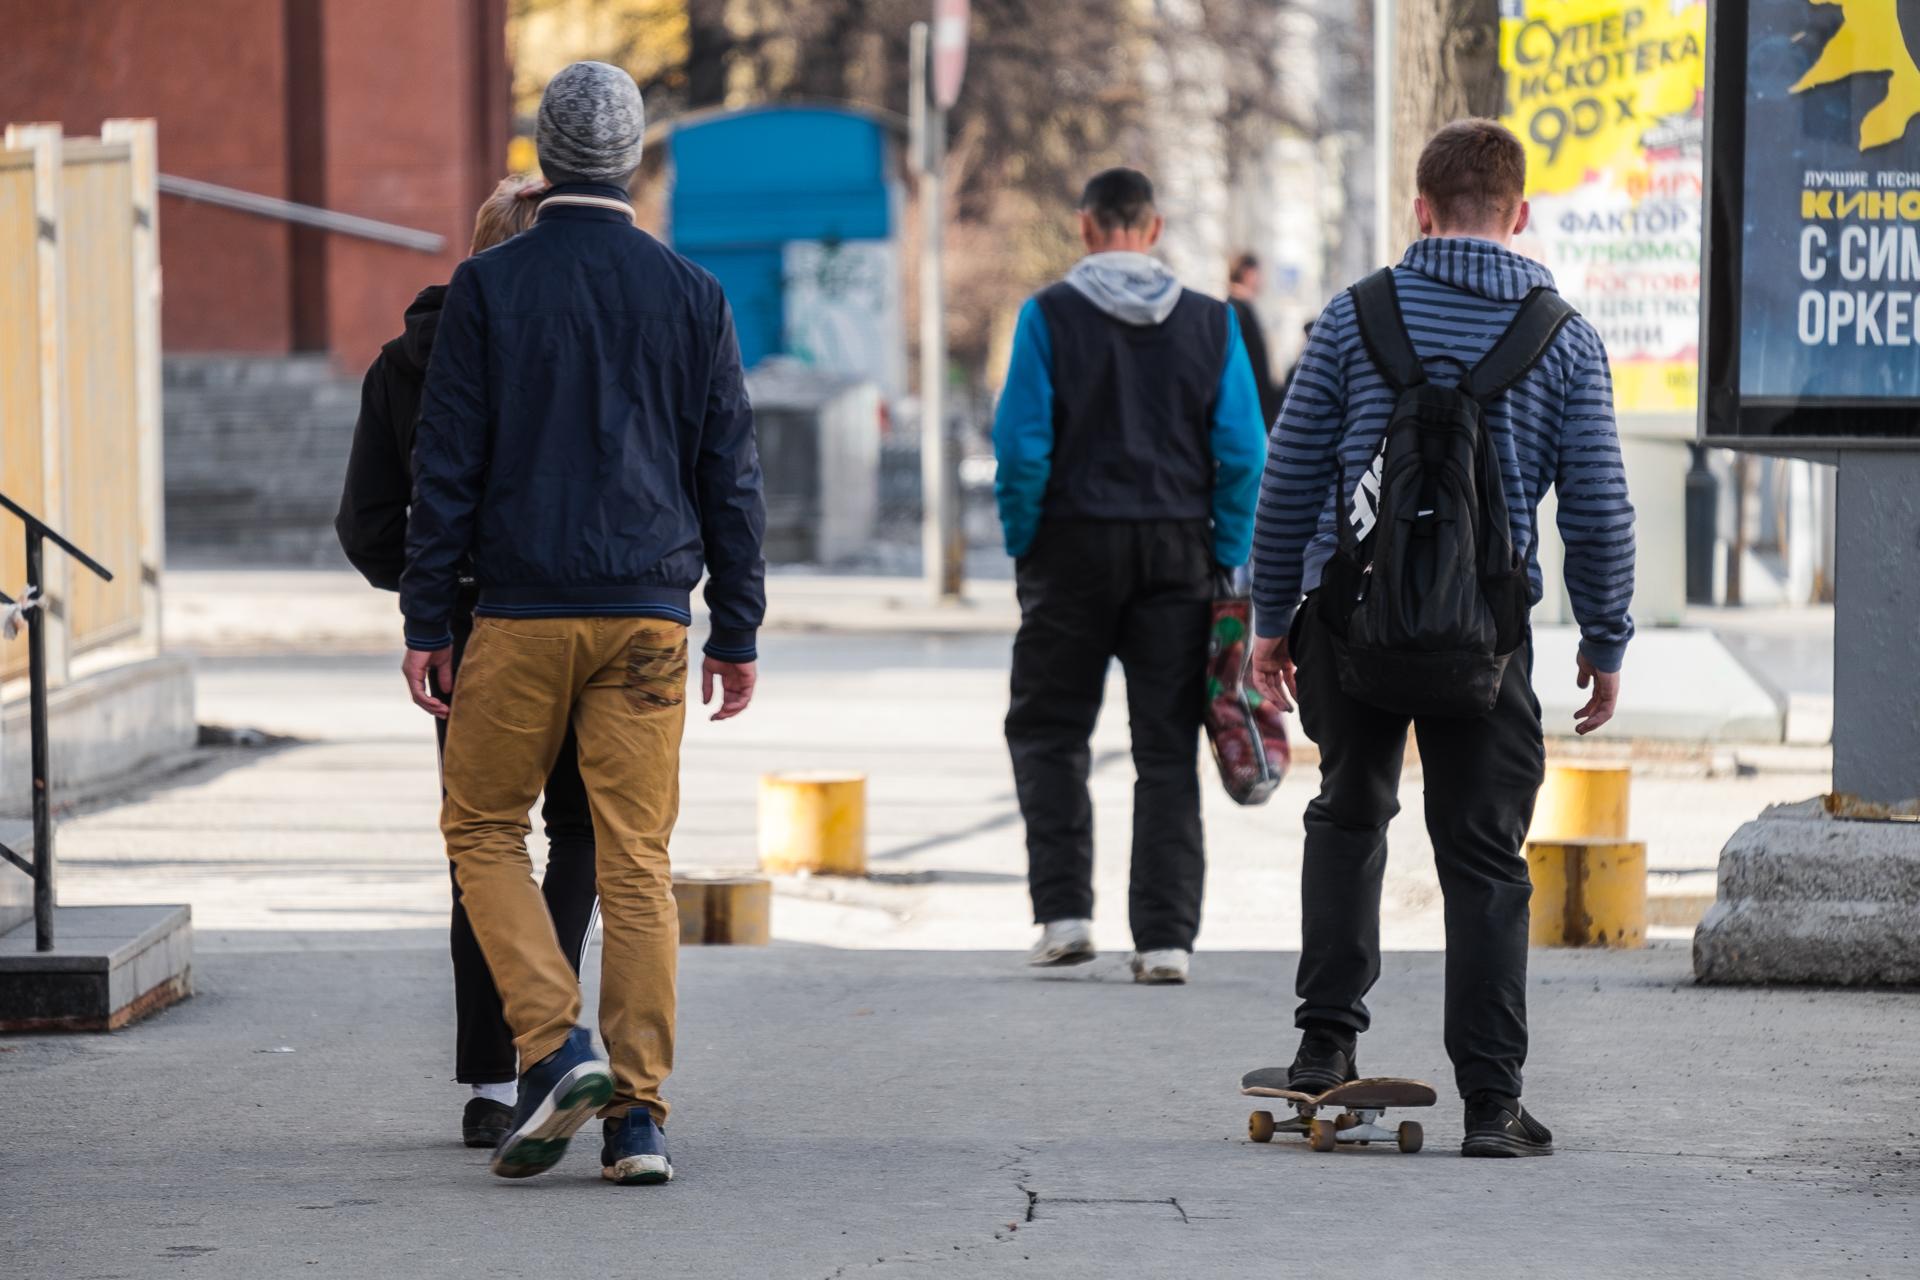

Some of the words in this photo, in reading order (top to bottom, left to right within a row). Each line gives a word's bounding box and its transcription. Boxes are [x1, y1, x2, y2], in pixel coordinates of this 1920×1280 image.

[1504, 34, 1699, 116] ИСКОТЕКА
[1804, 170, 1868, 188] ЛУЧШИЕ
[1559, 206, 1689, 234] ФАКТОР
[1802, 191, 1920, 220] КИНО
[1556, 240, 1700, 264] ТУРБОМО
[1800, 224, 1827, 281] С
[1798, 289, 1920, 346] ОРКЕ
